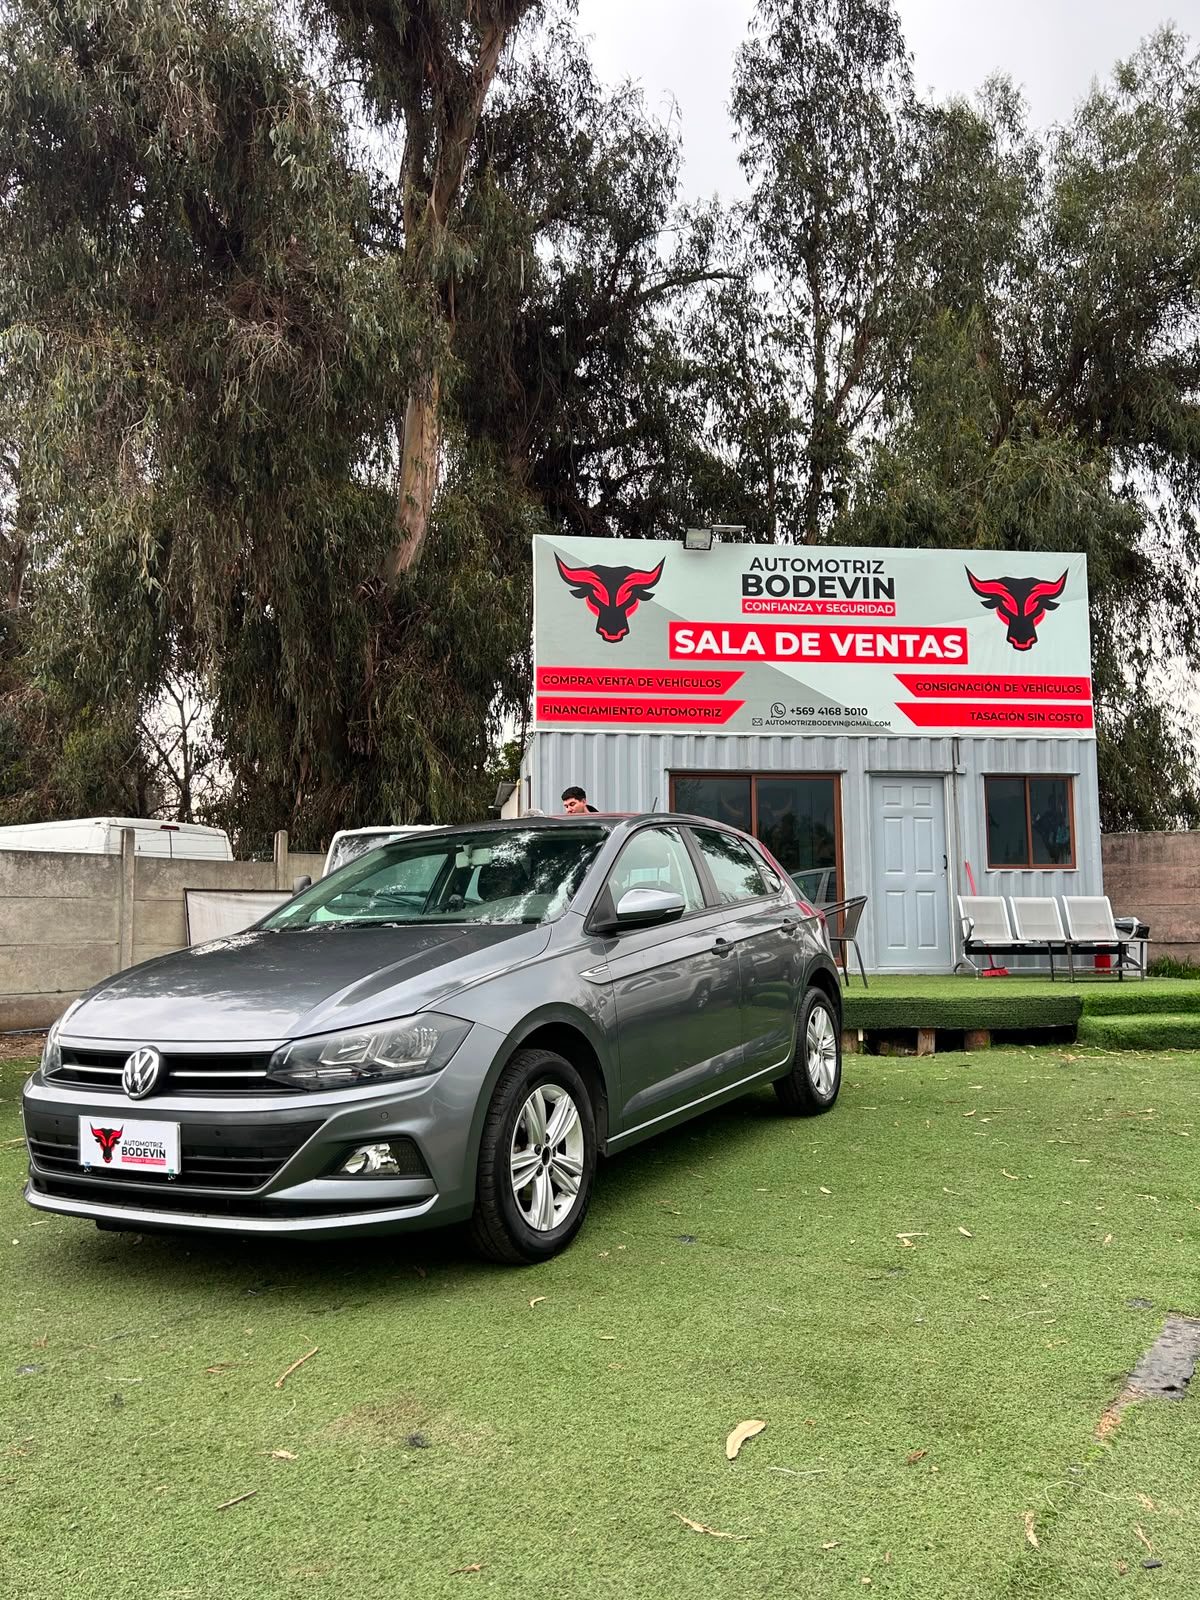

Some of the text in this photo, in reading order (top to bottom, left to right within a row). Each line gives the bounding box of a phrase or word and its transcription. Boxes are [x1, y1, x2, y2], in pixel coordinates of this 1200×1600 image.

[749, 557, 885, 574] AUTOMOTRIZ
[741, 574, 895, 600] BODEVIN
[745, 601, 894, 614] CONFIANZA Y SEGURIDAD
[674, 629, 963, 659] SALA DE VENTAS
[542, 675, 722, 688] COMPRA VENTA DE VEHÍCULOS
[915, 681, 1082, 694] CONSIGNACIÓN DE VEHÍCULOS
[542, 705, 722, 718] FINANCIAMIENTO AUTOMOTRIZ
[790, 706, 868, 716] +569 4168 5010
[970, 710, 1084, 723] TASACIÓN SIN COSTO
[765, 719, 891, 728] AUTOMOTRIZBODEVIN@GMAIL.COM
[123, 1139, 163, 1149] AUTOMOTRIZ
[121, 1146, 166, 1159] BODEVIN
